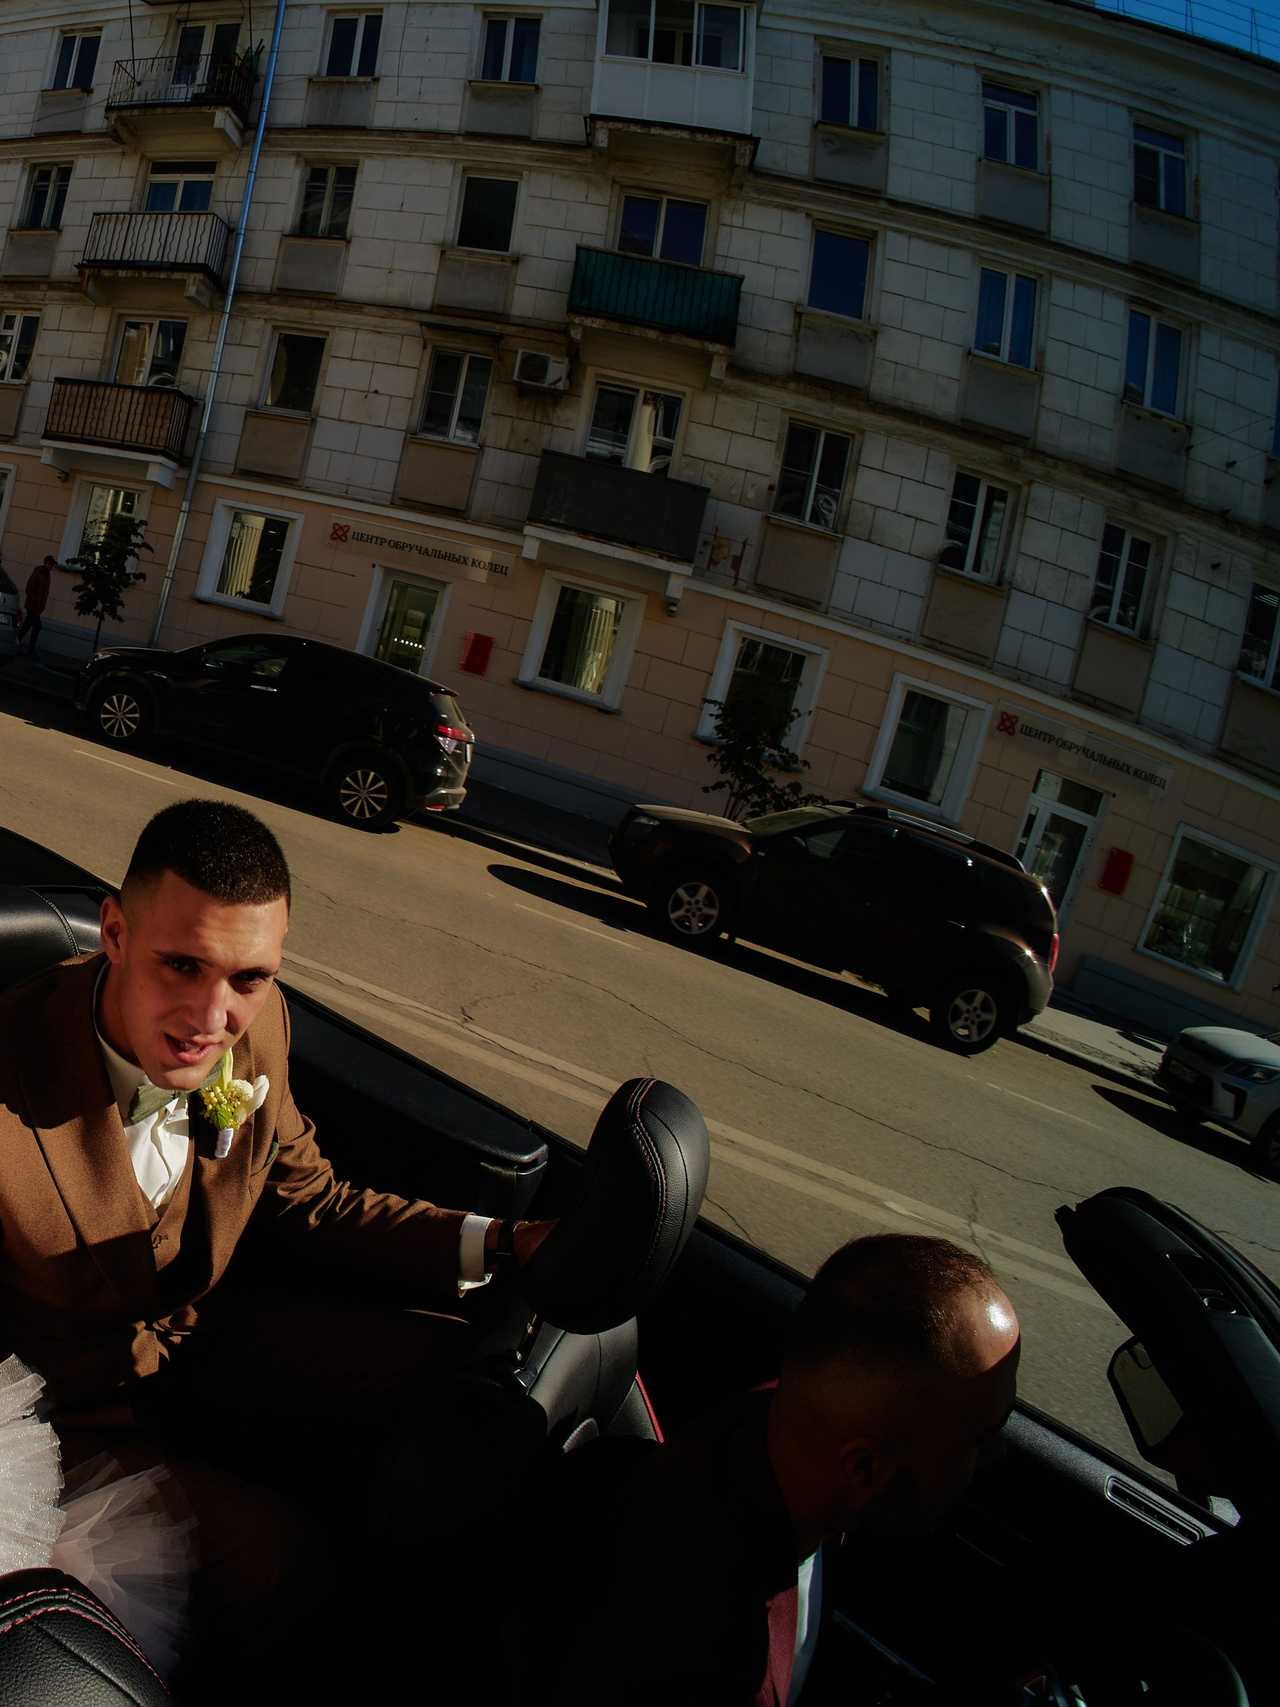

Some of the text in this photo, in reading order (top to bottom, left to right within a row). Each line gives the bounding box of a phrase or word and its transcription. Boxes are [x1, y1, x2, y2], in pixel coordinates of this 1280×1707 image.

[351, 531, 509, 577] ЦЕНТР ОБРУЧАЛЬНЫХ КОЛЕЦ
[1019, 723, 1168, 791] ЦЕНТР ОБРУЧАЛЬНЫХ КОЛЕЦ
